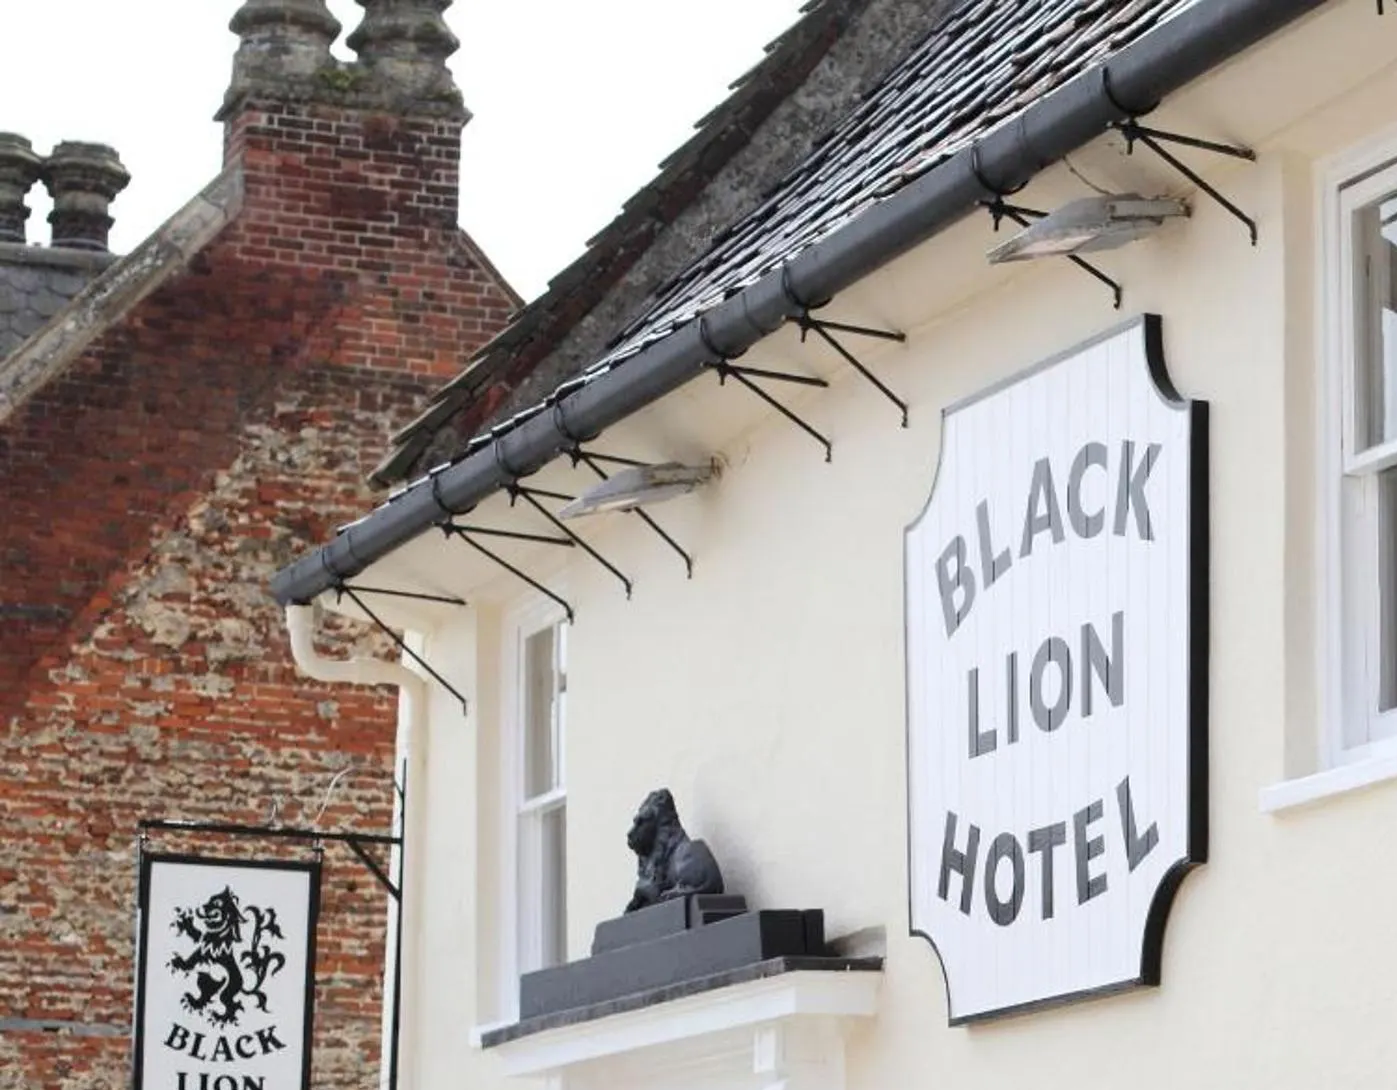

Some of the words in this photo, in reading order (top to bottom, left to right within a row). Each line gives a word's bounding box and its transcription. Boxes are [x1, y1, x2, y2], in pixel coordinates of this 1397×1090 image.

[934, 439, 1163, 639] BLACK
[967, 610, 1125, 760] LION
[937, 775, 1160, 927] HOTEL
[164, 1022, 287, 1062] BLACK
